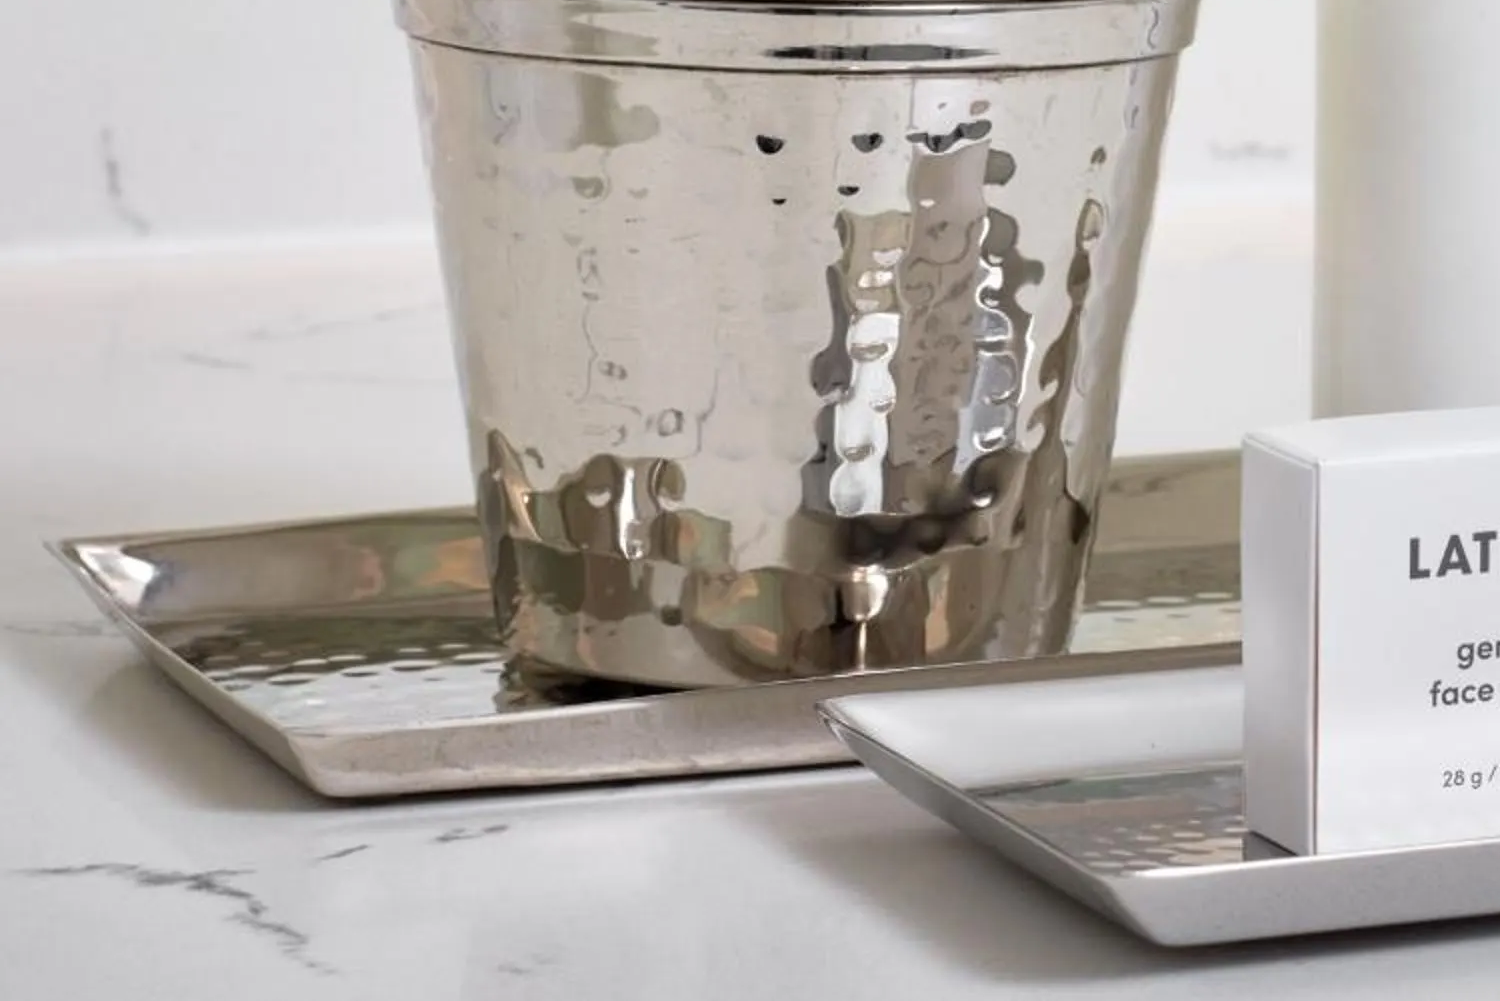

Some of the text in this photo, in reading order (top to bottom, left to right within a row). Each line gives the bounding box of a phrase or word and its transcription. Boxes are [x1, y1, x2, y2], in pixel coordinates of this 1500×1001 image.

[1429, 680, 1494, 707] face
[1443, 769, 1465, 788] 28
[1470, 771, 1483, 790] g
[1488, 765, 1498, 783] /
